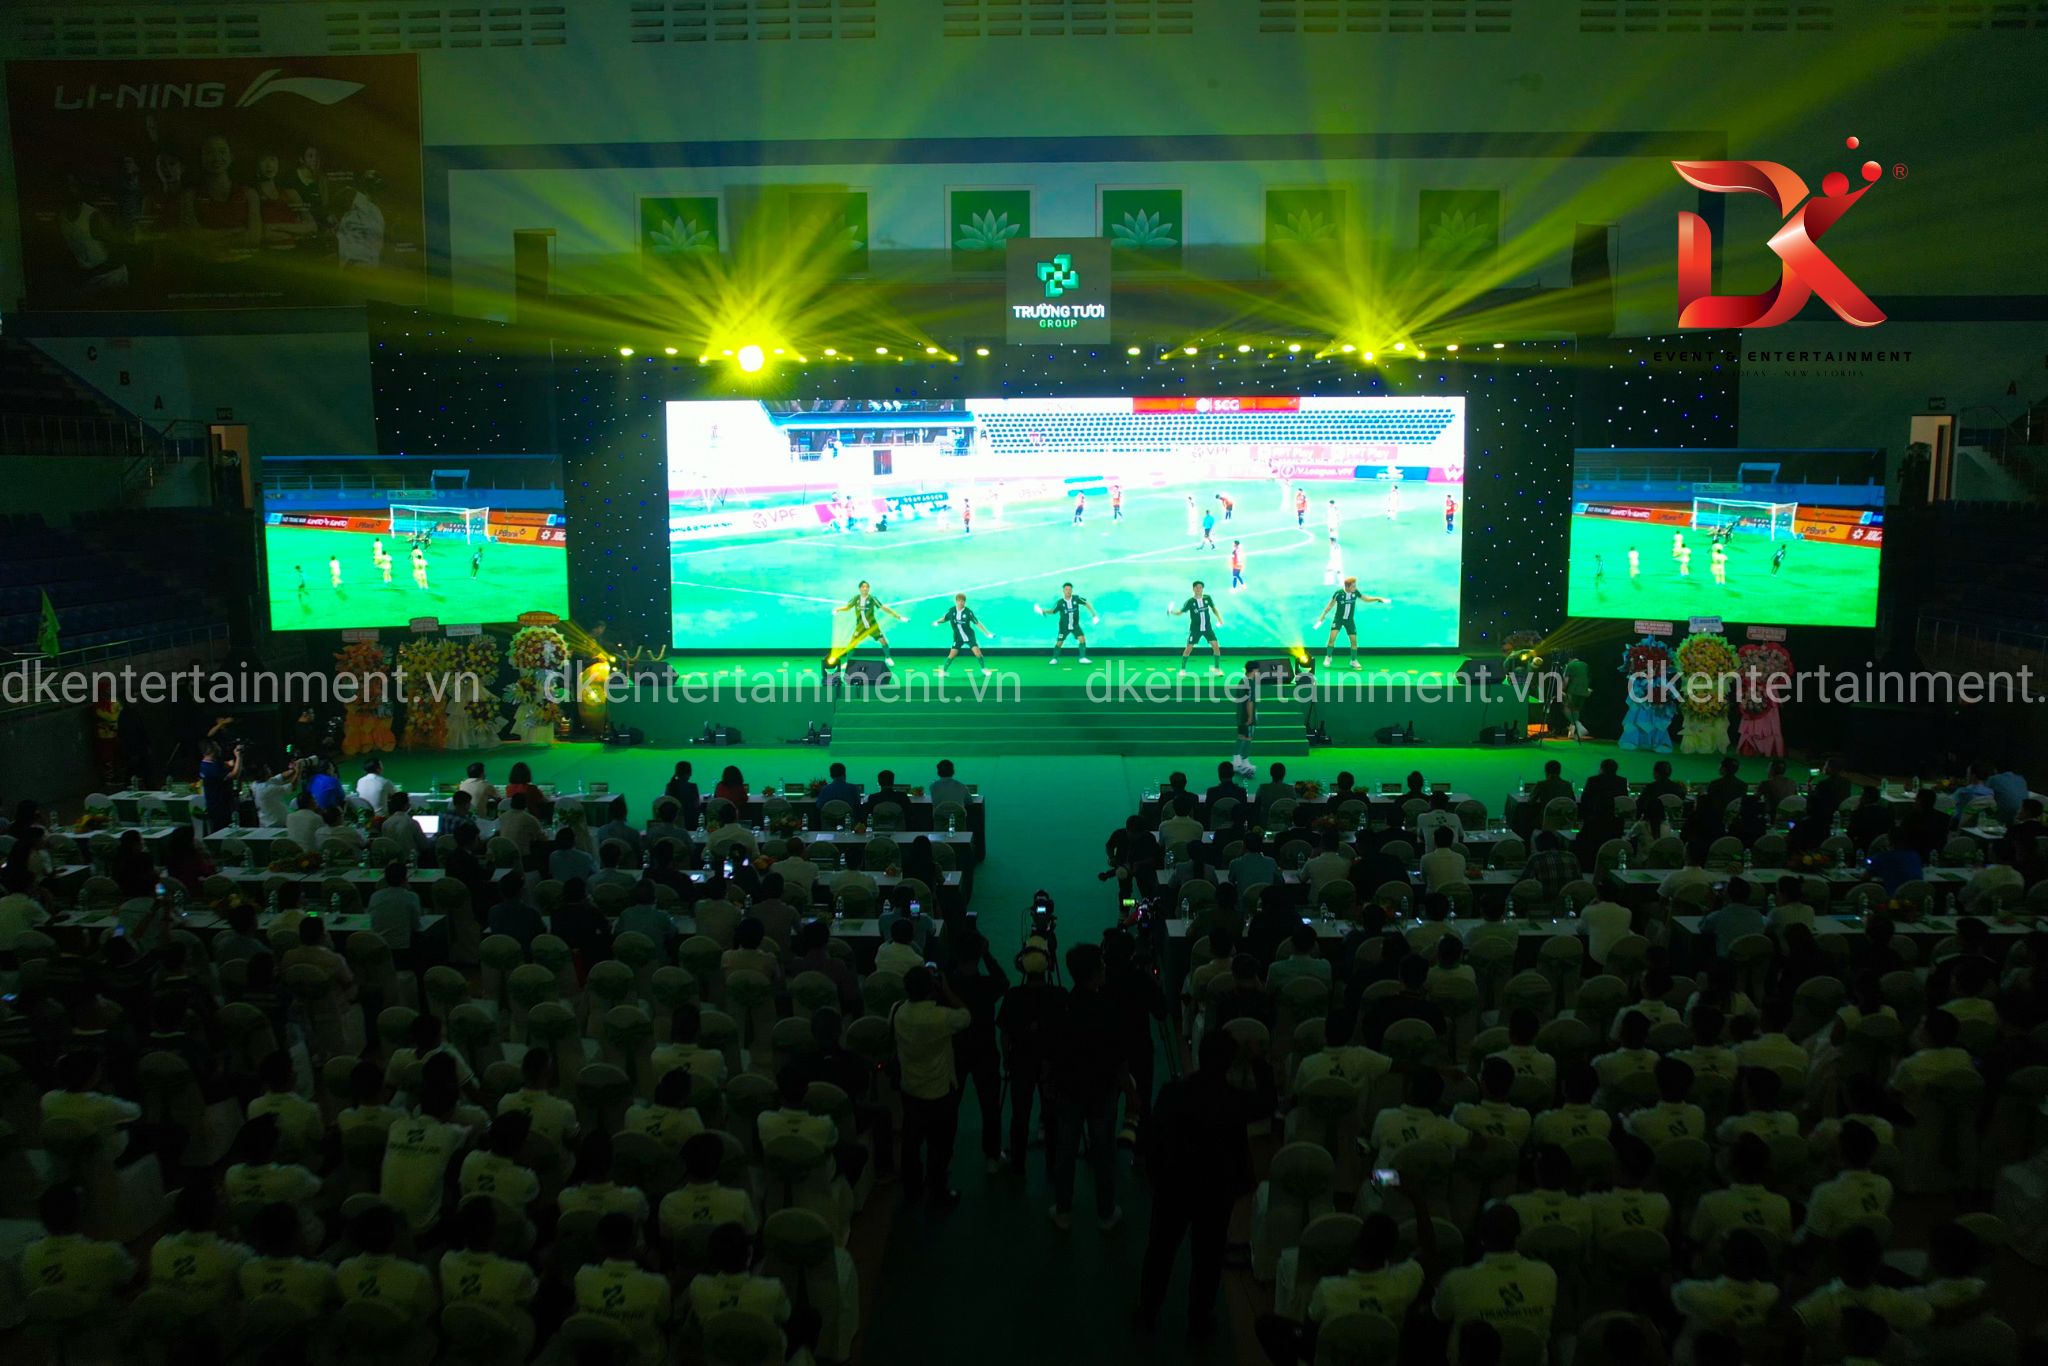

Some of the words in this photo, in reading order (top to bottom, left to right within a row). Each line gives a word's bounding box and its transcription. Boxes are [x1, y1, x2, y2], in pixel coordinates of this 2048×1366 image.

[55, 83, 226, 110] LI-NING
[1012, 303, 1070, 318] TRƯỜNG
[1071, 304, 1105, 318] TƯƠI
[1039, 319, 1077, 328] GROUP
